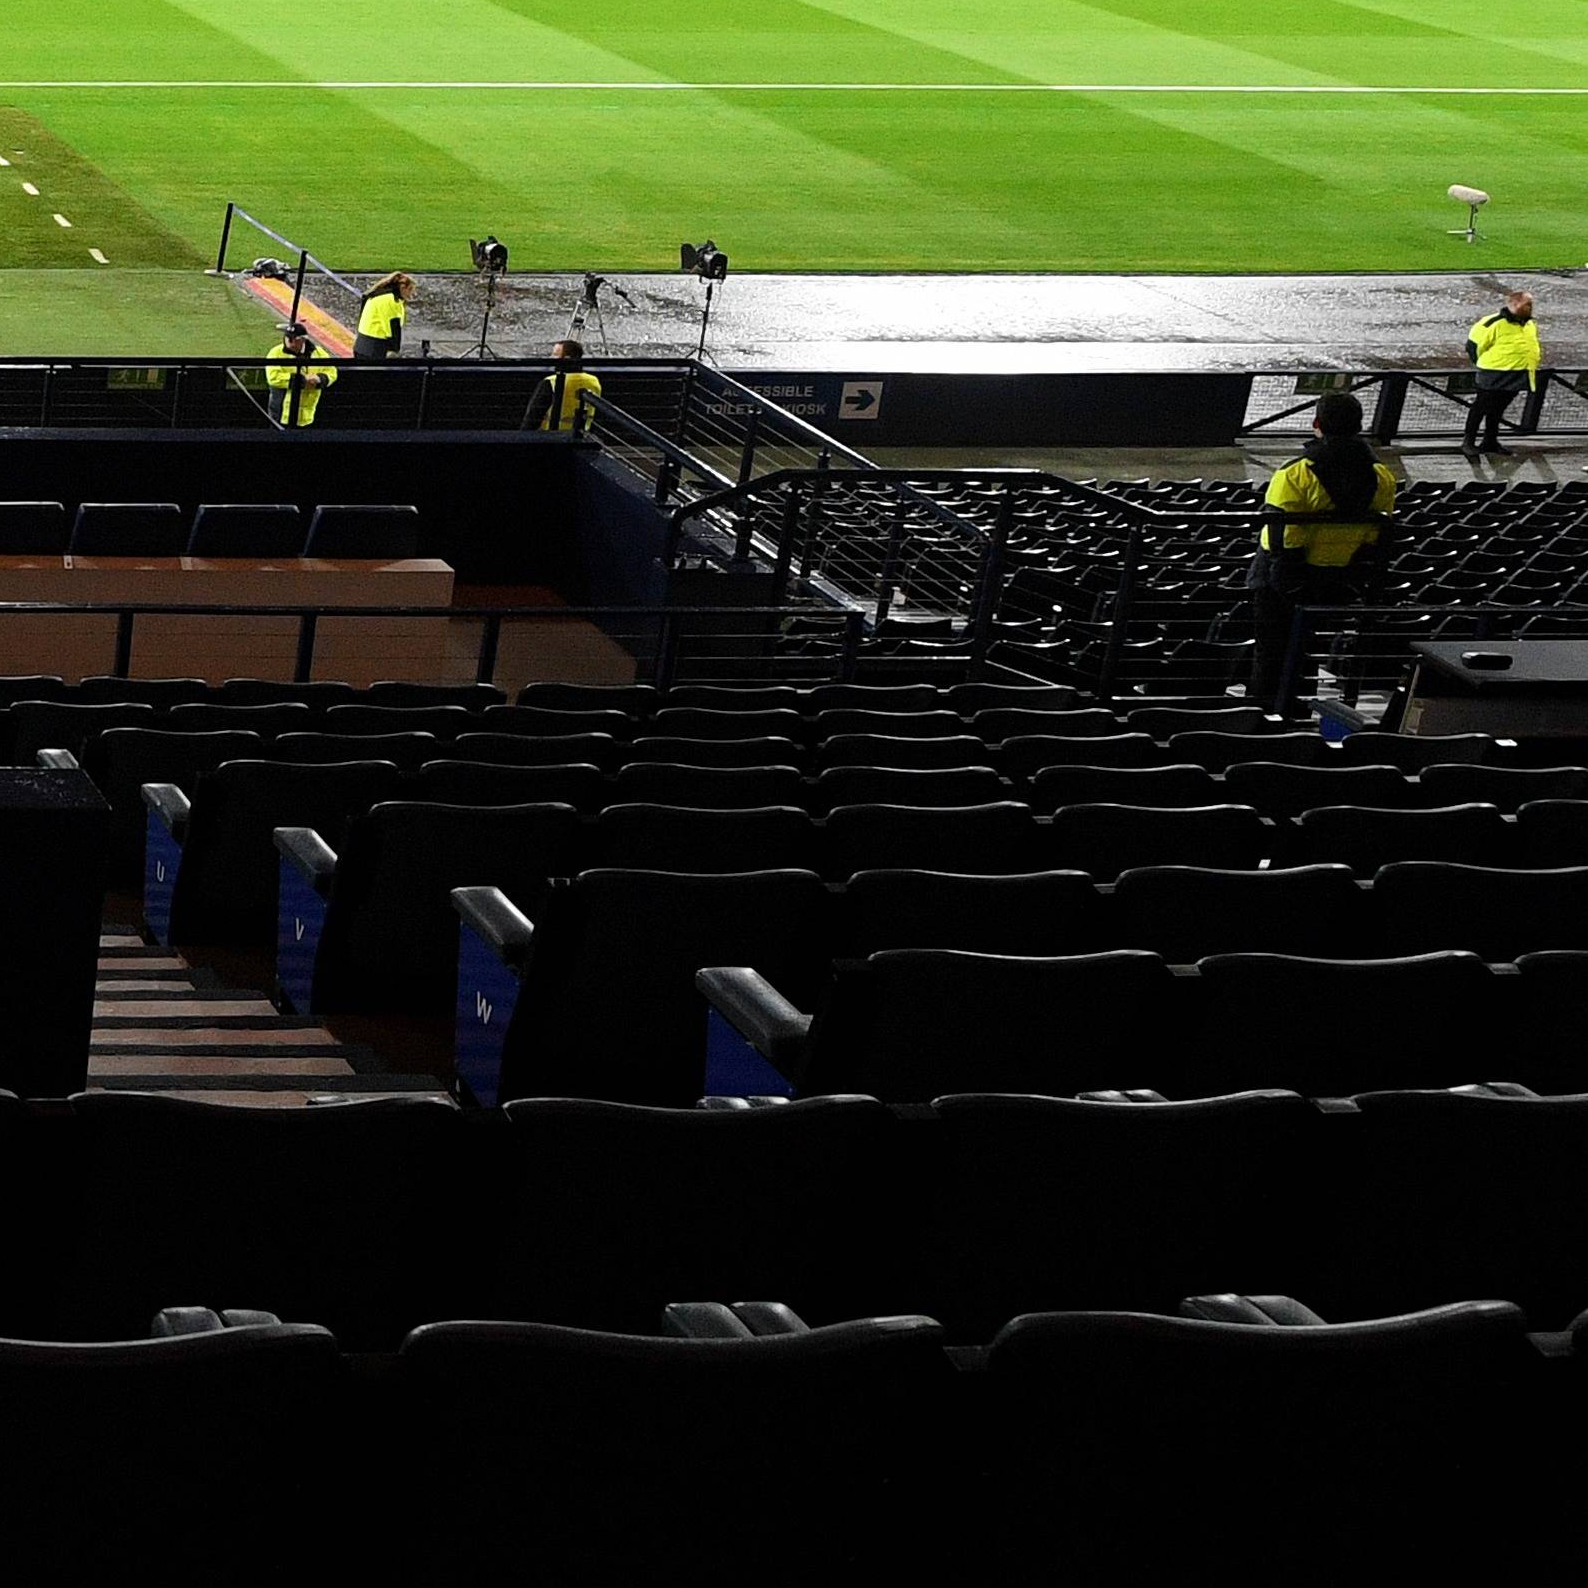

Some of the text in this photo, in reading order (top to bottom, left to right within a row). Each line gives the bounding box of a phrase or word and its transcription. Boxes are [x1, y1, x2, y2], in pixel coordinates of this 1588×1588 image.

[156, 860, 166, 882] U
[296, 917, 306, 941] V
[476, 990, 493, 1024] W
